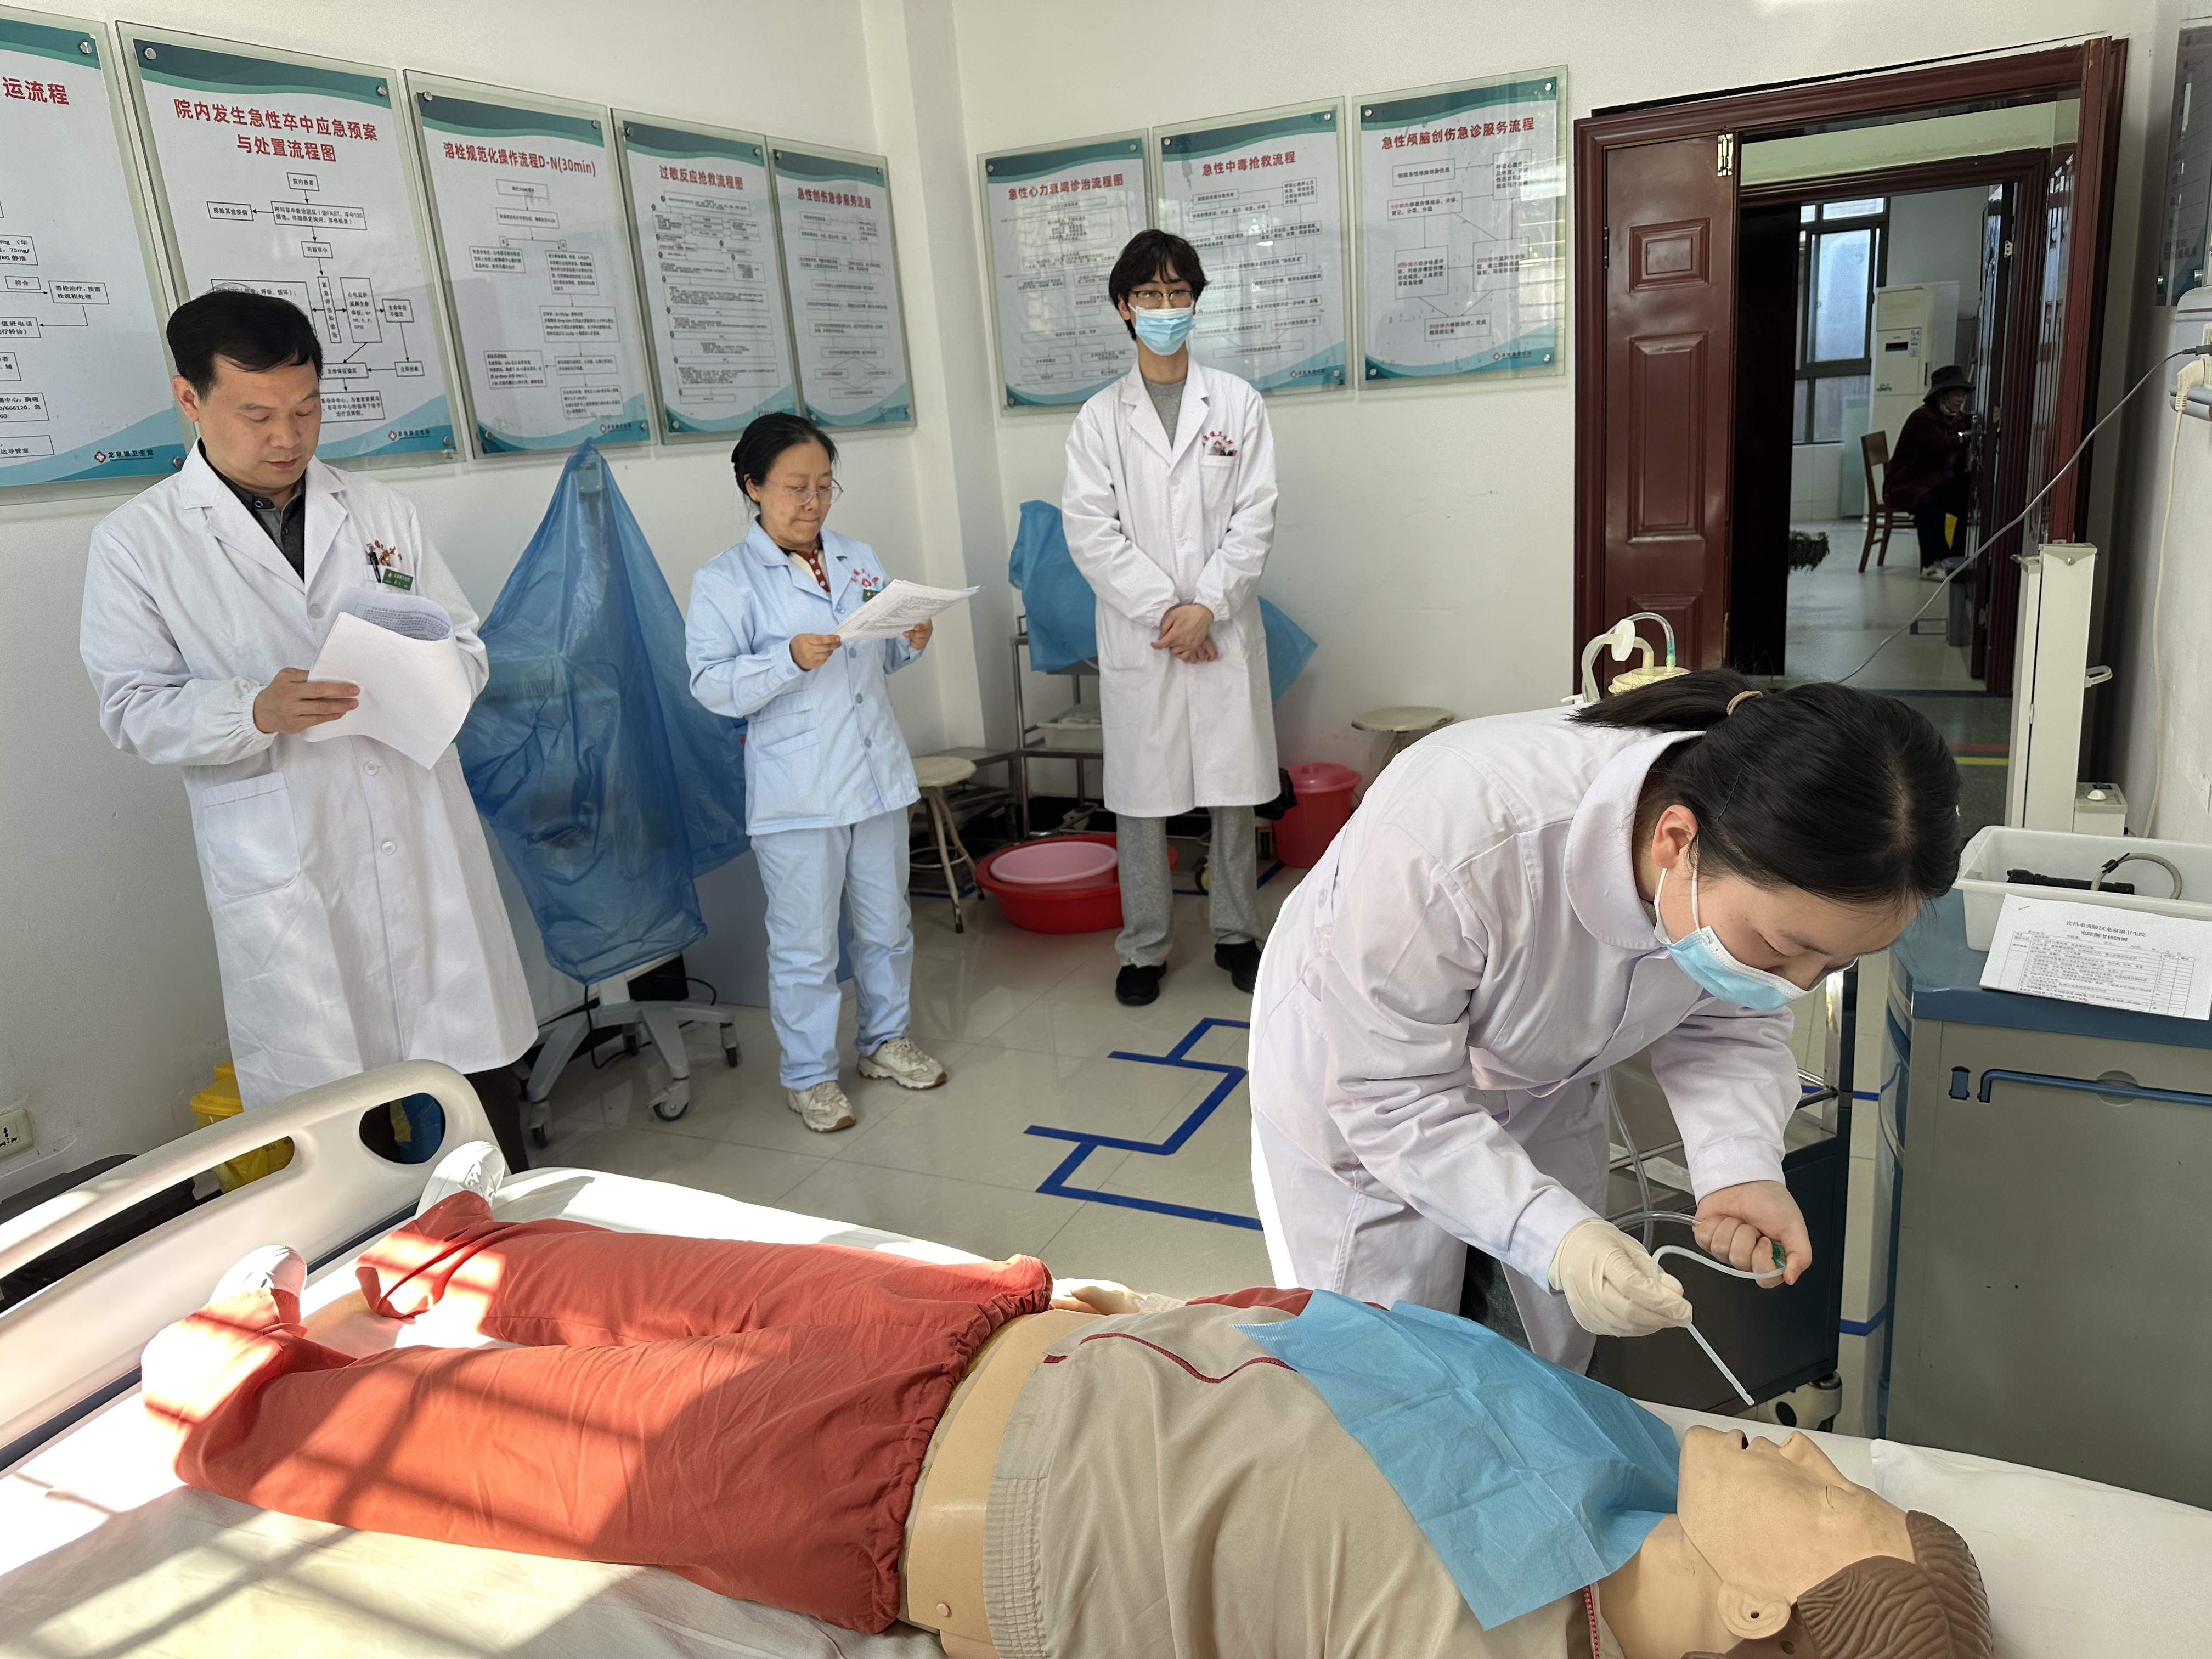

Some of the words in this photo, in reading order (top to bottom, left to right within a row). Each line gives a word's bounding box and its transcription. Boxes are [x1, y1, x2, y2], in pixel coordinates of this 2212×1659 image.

[2, 76, 70, 105] 运流程
[173, 98, 379, 142] 院内发生急性卒中应急预案
[1382, 117, 1534, 150] 急性颅脑创伤急诊服务流程
[236, 134, 337, 162] 与处置流程图
[659, 165, 743, 190] 过敏反应抢救流程图
[1202, 150, 1296, 177] 急性中毒抢救流程
